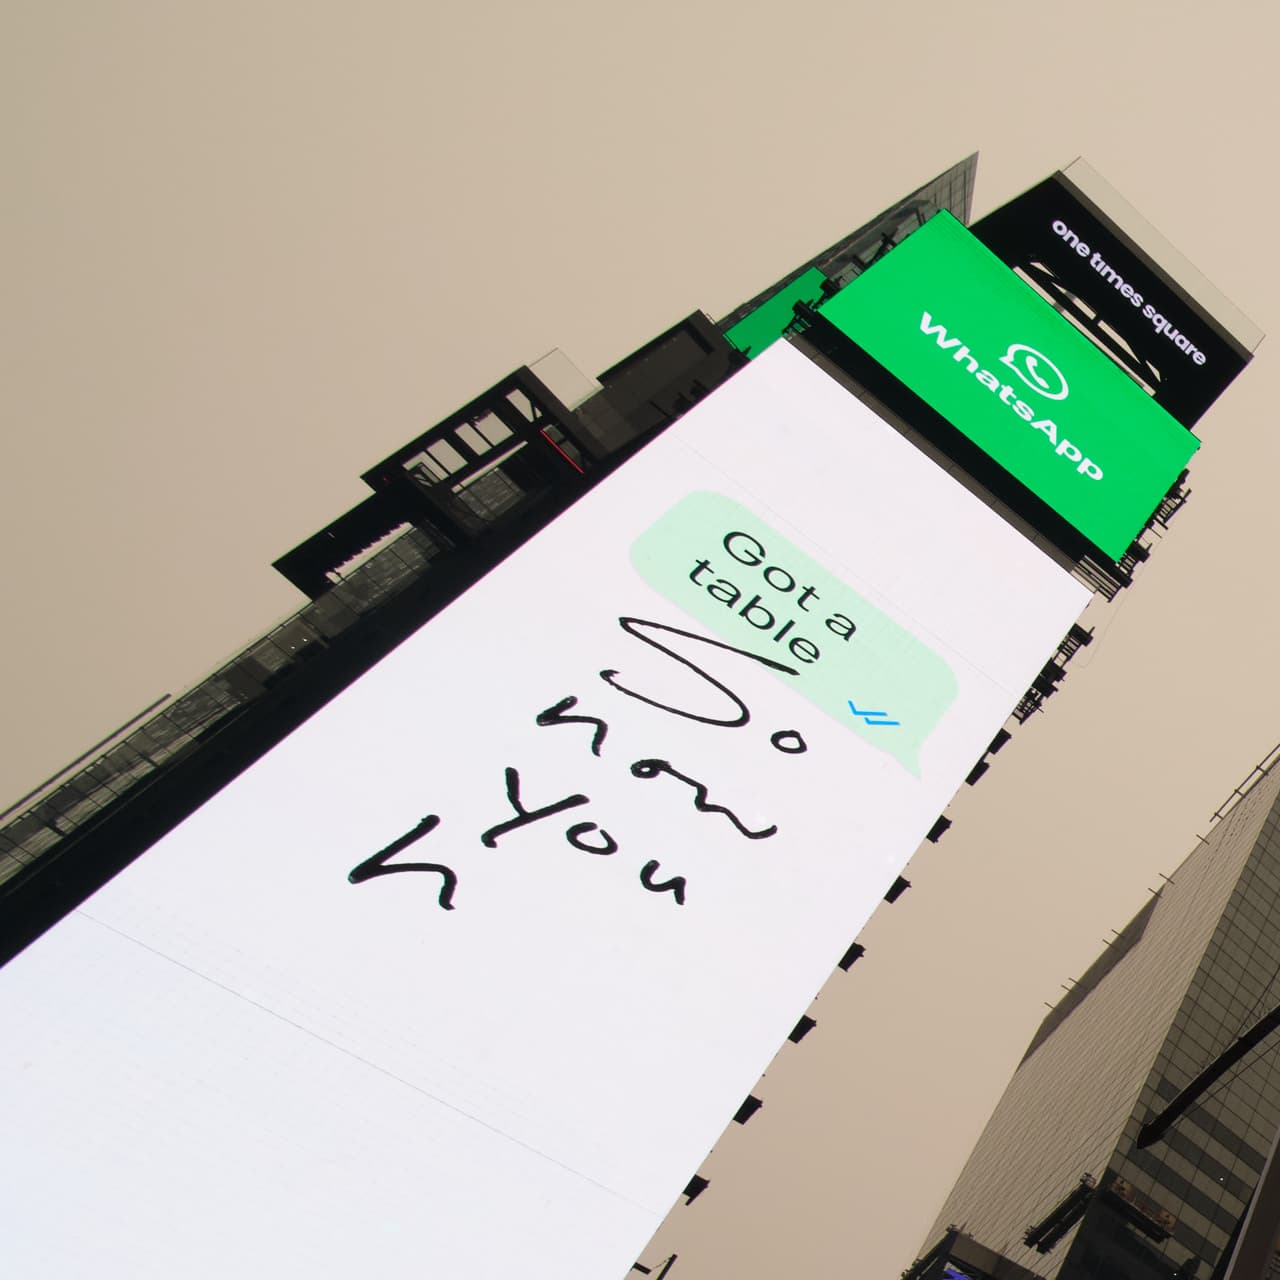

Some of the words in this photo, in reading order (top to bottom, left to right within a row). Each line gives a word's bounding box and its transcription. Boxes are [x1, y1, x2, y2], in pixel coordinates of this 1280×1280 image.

[1052, 219, 1090, 258] one
[1090, 252, 1143, 308] times
[1142, 304, 1207, 366] square
[919, 311, 1104, 481] WhatsApp
[689, 559, 821, 666] table
[722, 530, 821, 613] Got
[825, 613, 857, 642] a
